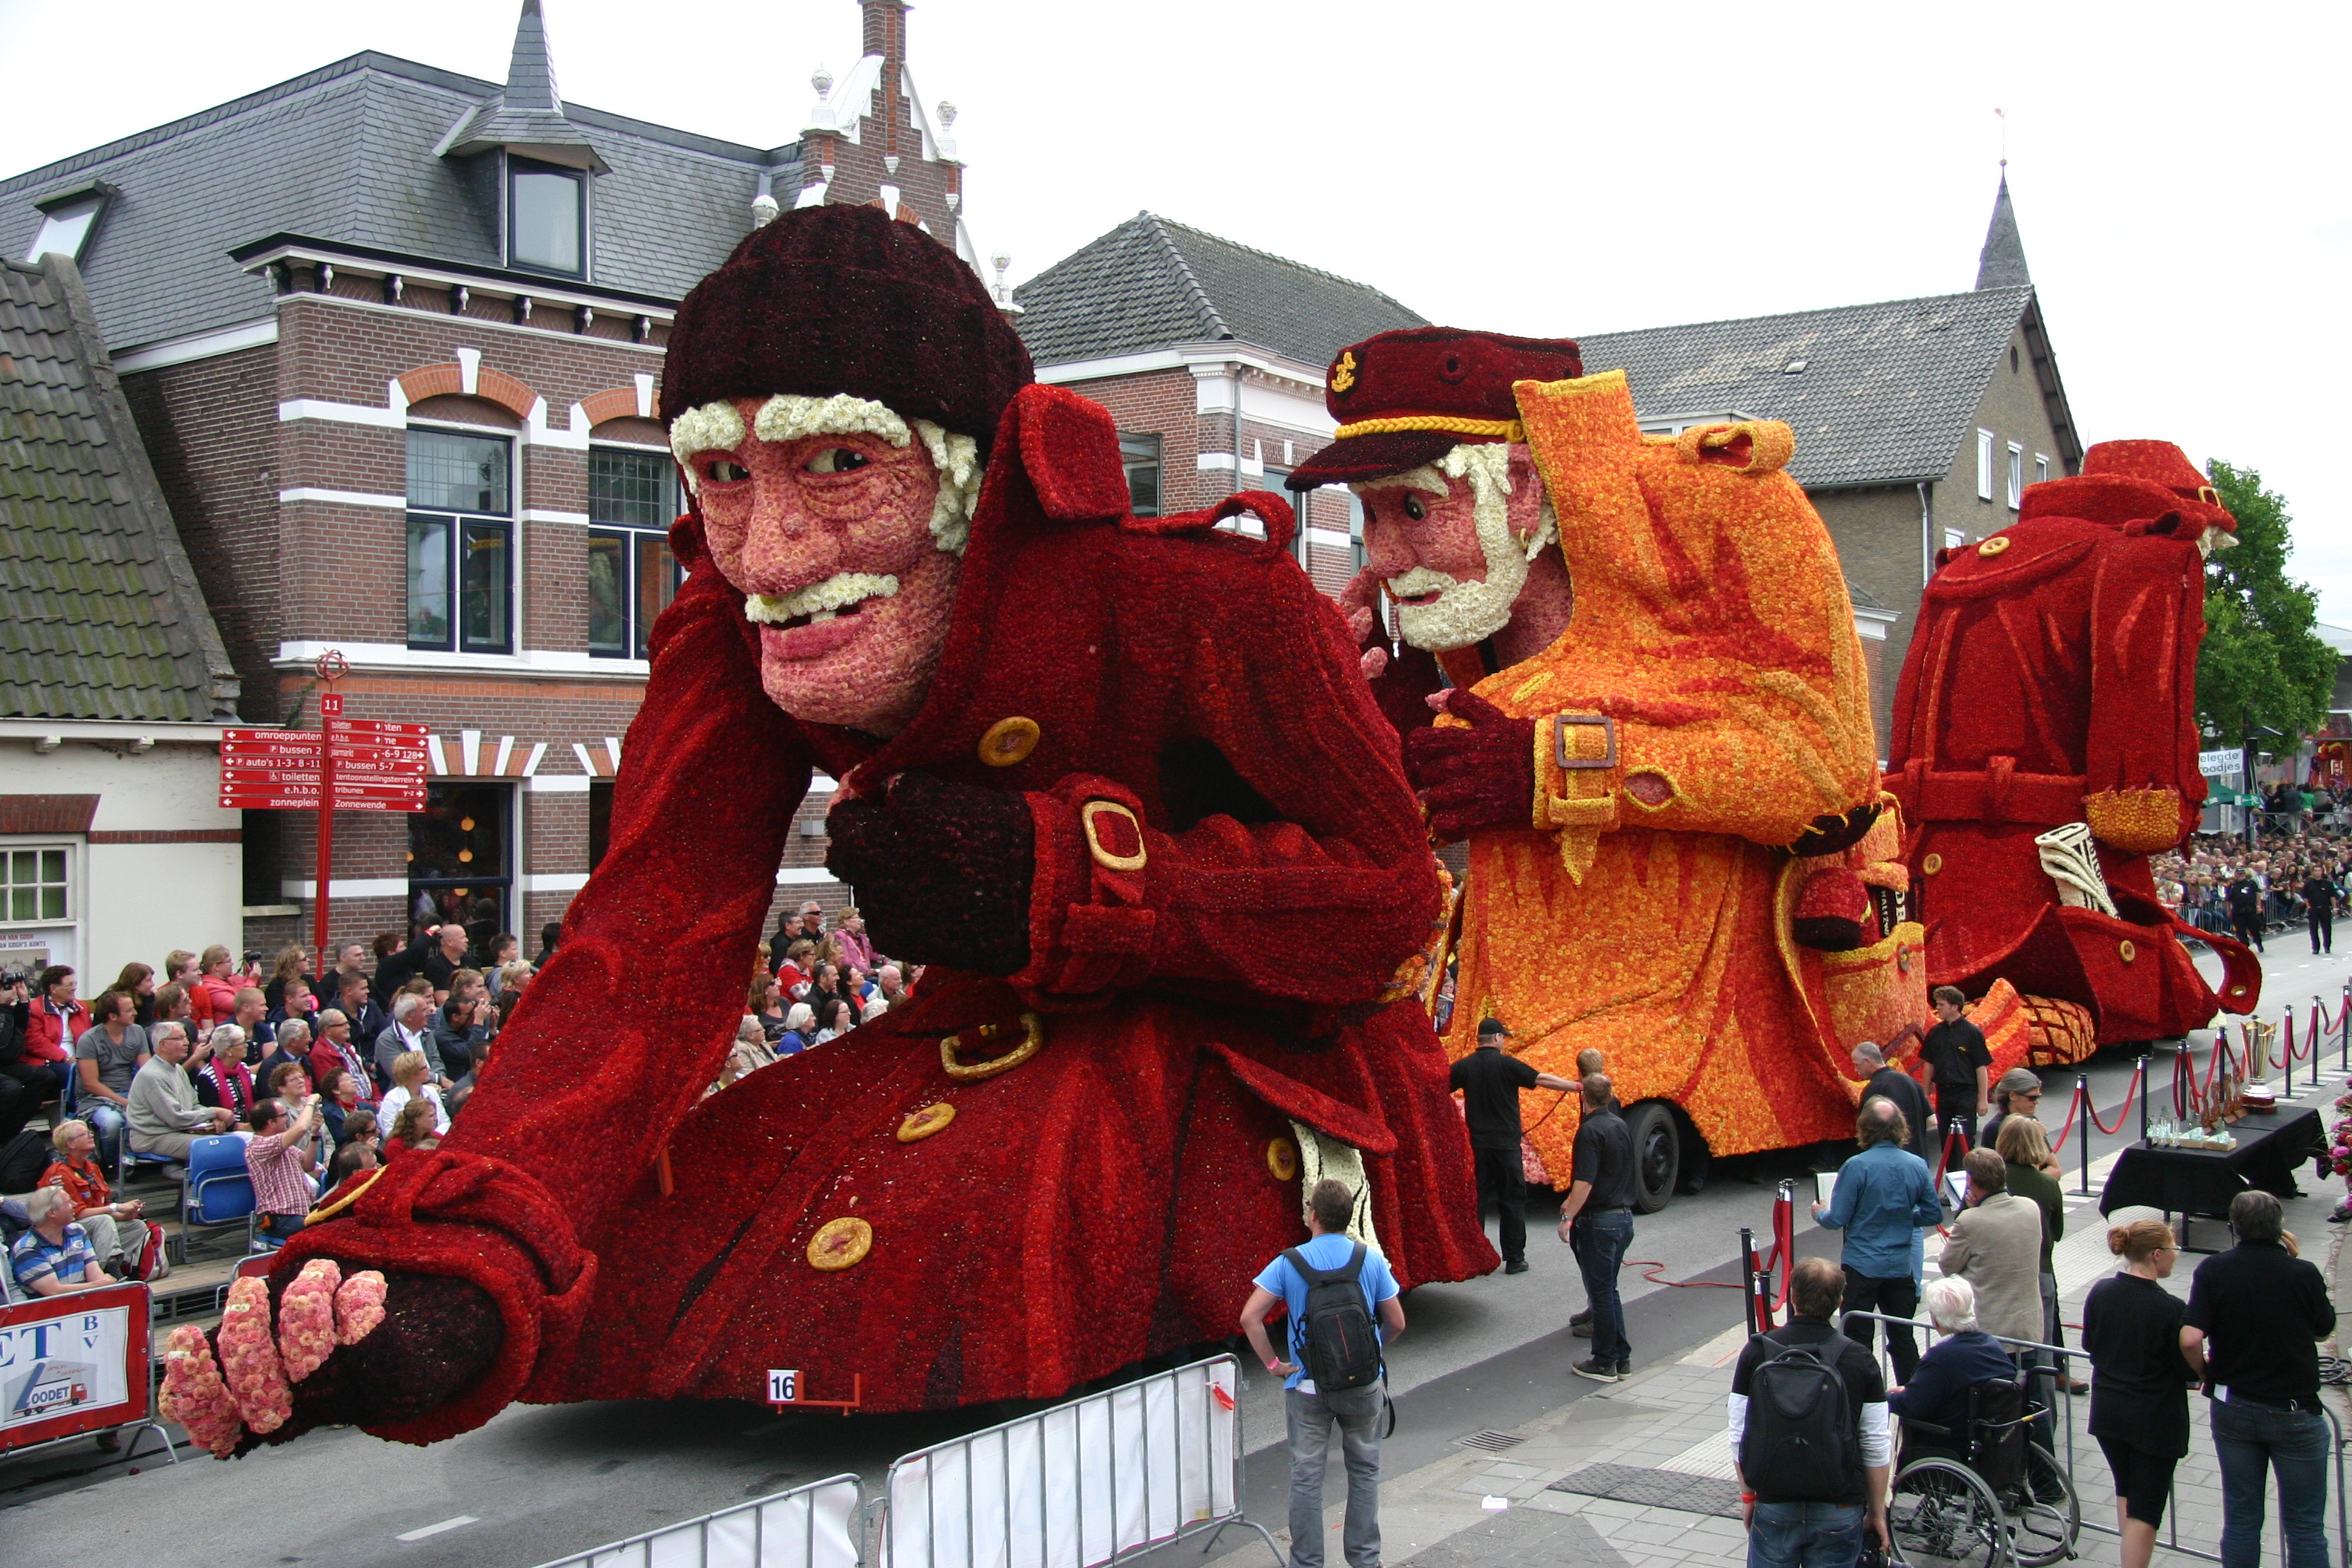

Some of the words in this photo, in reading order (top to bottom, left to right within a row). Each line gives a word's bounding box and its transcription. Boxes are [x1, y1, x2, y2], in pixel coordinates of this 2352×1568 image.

[325, 699, 339, 710] 11
[254, 731, 322, 741] omroeppunten
[279, 746, 312, 755] bussen
[315, 746, 322, 755] 2
[246, 758, 273, 767] auto's
[345, 761, 377, 770] bussen
[379, 762, 395, 771] 5-7
[282, 773, 320, 781] toiletten
[335, 773, 414, 784] tentoonstellingsterrein
[284, 786, 320, 795] e.h.b.o.
[335, 786, 364, 795] tribunes
[270, 799, 319, 808] zonneplein
[335, 799, 387, 809] Zonnewende
[83, 1315, 100, 1331] B
[82, 1334, 100, 1350] V
[771, 1376, 795, 1399] 16
